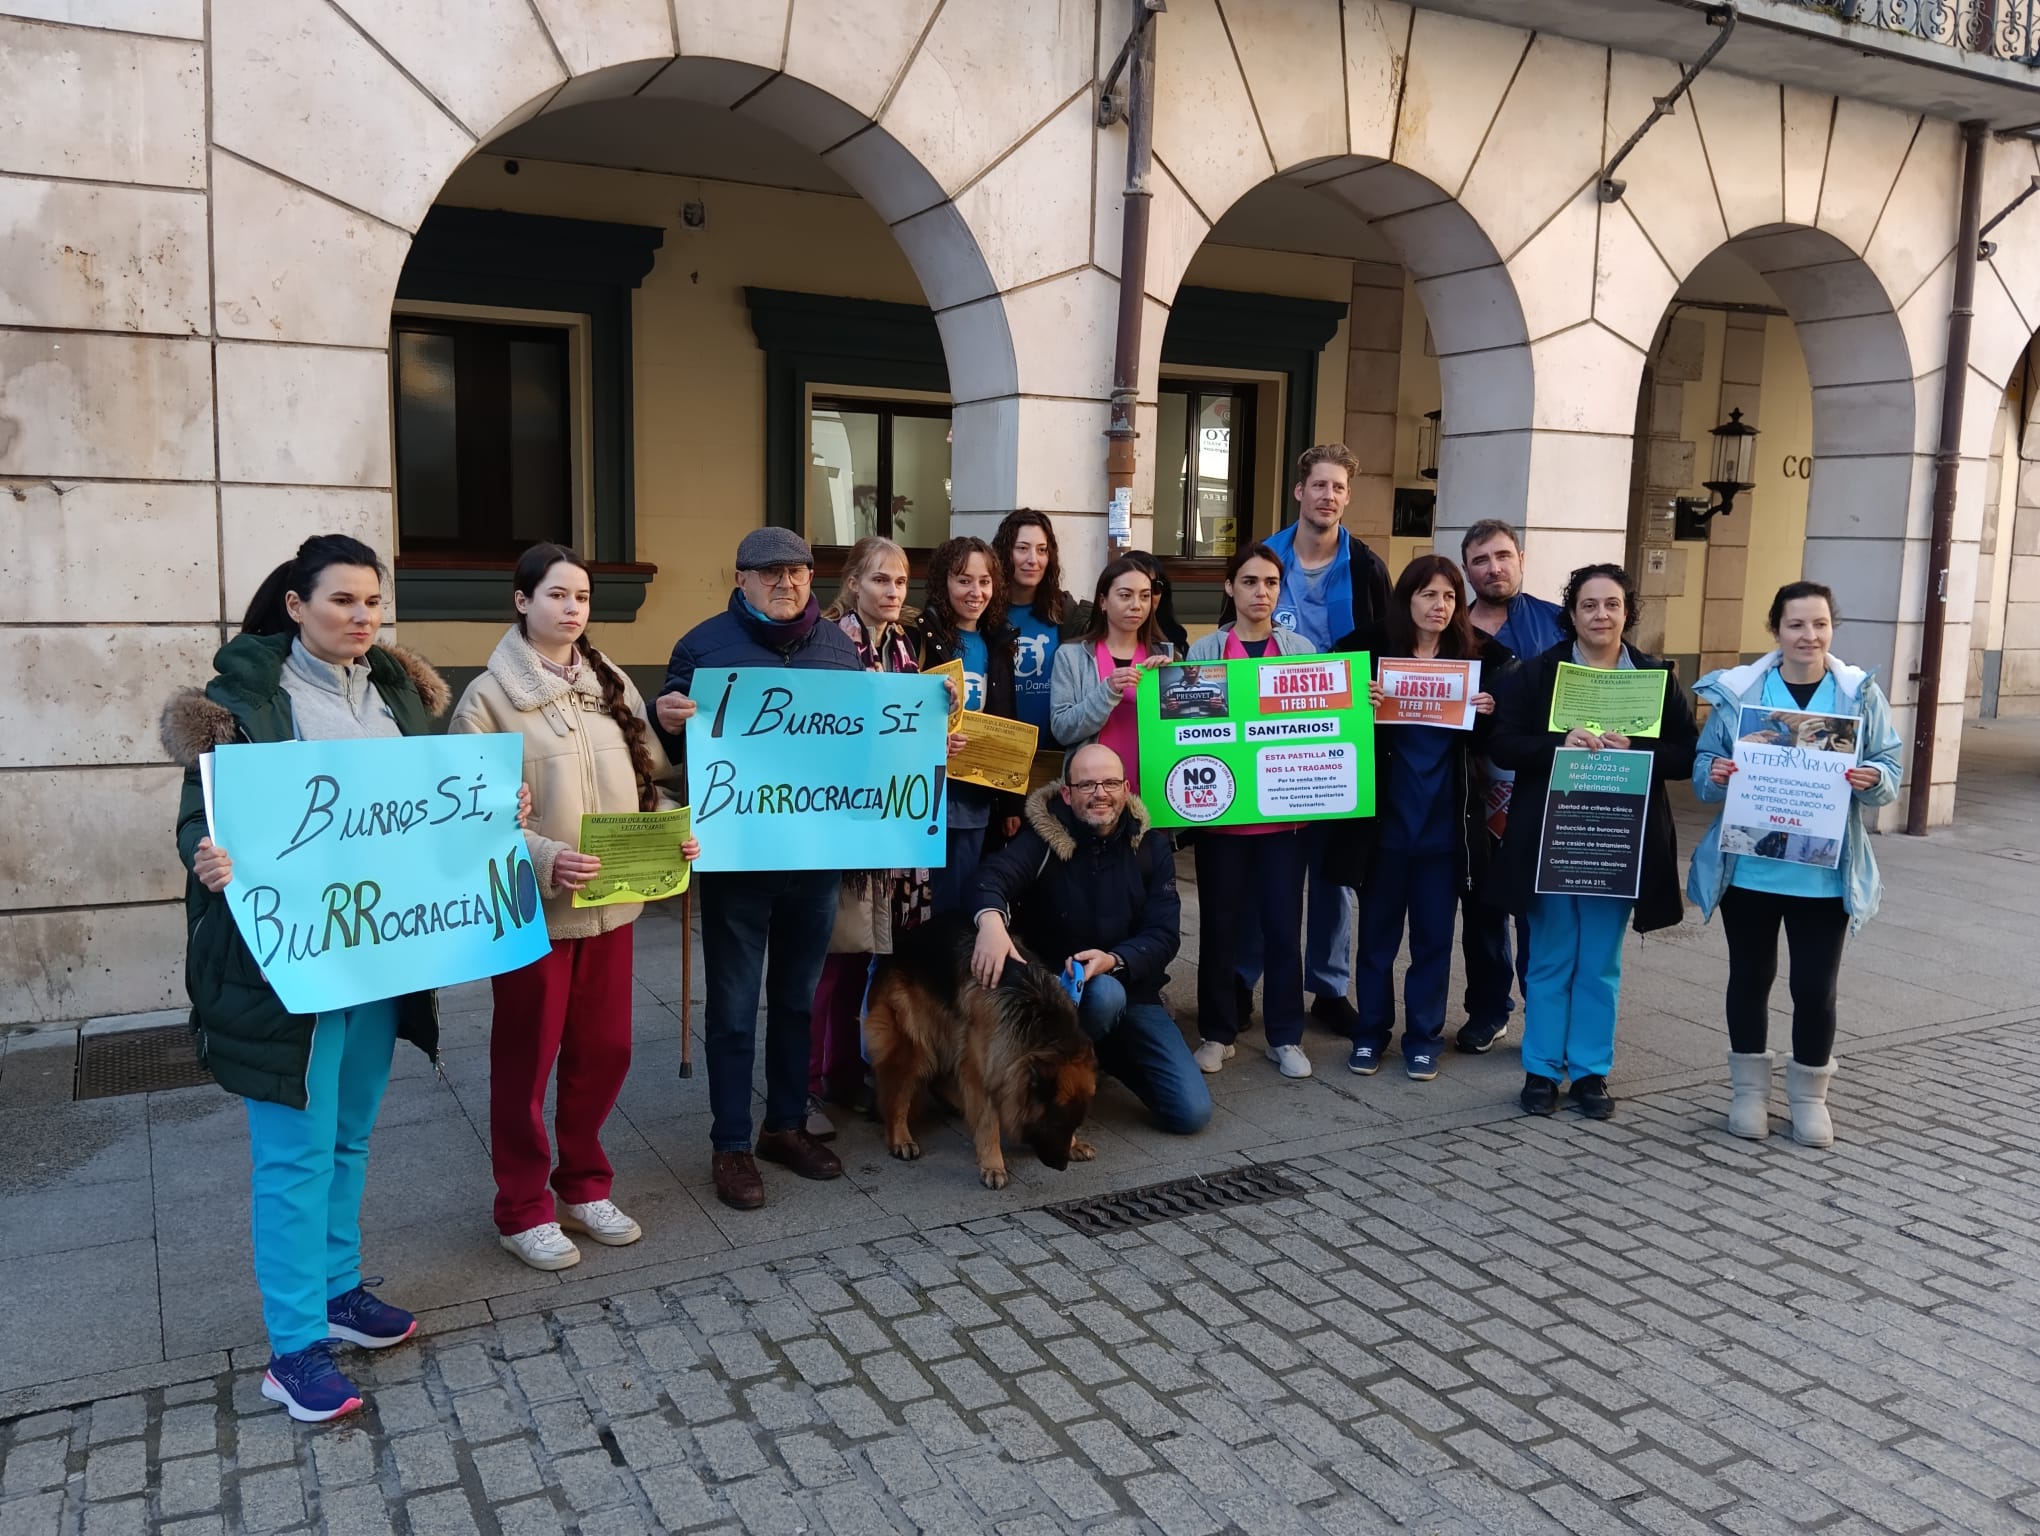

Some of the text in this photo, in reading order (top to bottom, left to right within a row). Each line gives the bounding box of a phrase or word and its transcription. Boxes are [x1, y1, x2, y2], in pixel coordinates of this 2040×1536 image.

[1783, 455, 1812, 479] CO
[1273, 672, 1334, 694] ¡BASTA!
[1394, 680, 1451, 698] ¡BASTA!
[1280, 697, 1328, 710] 11 FEB 11 h.
[1400, 700, 1406, 710] 11
[1409, 701, 1422, 710] FEB
[1426, 701, 1432, 710] 11
[879, 701, 923, 735] SÍ
[1179, 722, 1334, 741] ¡SOMOS SANITARIOS!
[1328, 749, 1344, 758] NO
[1298, 764, 1343, 772] TRAGAMOS
[1580, 764, 1616, 772] 666/2023
[1184, 767, 1216, 786] NO
[1569, 773, 1628, 782] Medicamentos
[1574, 783, 1620, 792] Veterinarios
[1758, 776, 1830, 790] PROFESIONALIDAD
[1184, 790, 1218, 804] IVA
[1752, 794, 1788, 804] CRITERIO
[1779, 788, 1824, 799] CUESTIONA
[1766, 806, 1814, 818] CRIMINALIZA
[1770, 815, 1802, 826] NO AL
[1596, 826, 1630, 834] burocracia
